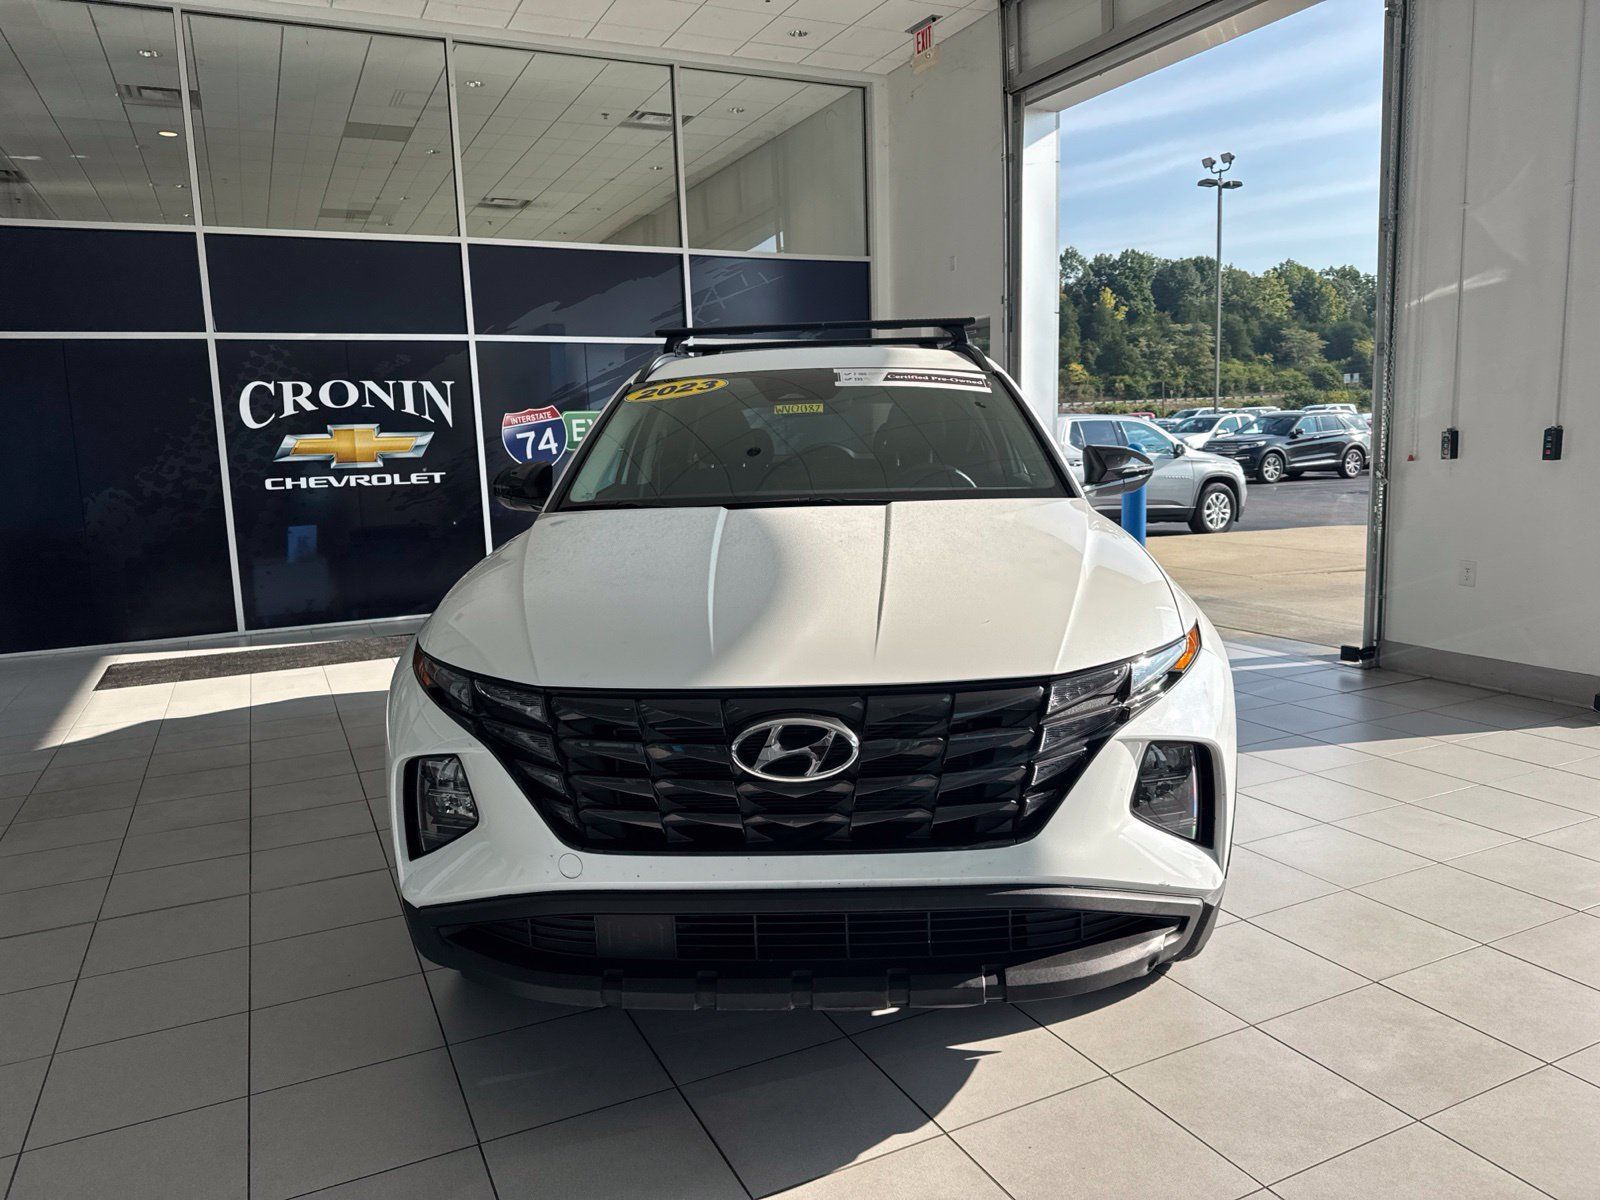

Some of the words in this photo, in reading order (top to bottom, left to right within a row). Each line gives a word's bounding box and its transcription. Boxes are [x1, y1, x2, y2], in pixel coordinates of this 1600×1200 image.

[916, 25, 932, 54] EXIT
[636, 379, 719, 400] 2023
[931, 376, 983, 385] Pre-Owned
[239, 380, 455, 429] CRONIN
[510, 411, 552, 425] INTERSTATE
[516, 427, 558, 460] 74
[265, 472, 446, 490] CHEVROLET
